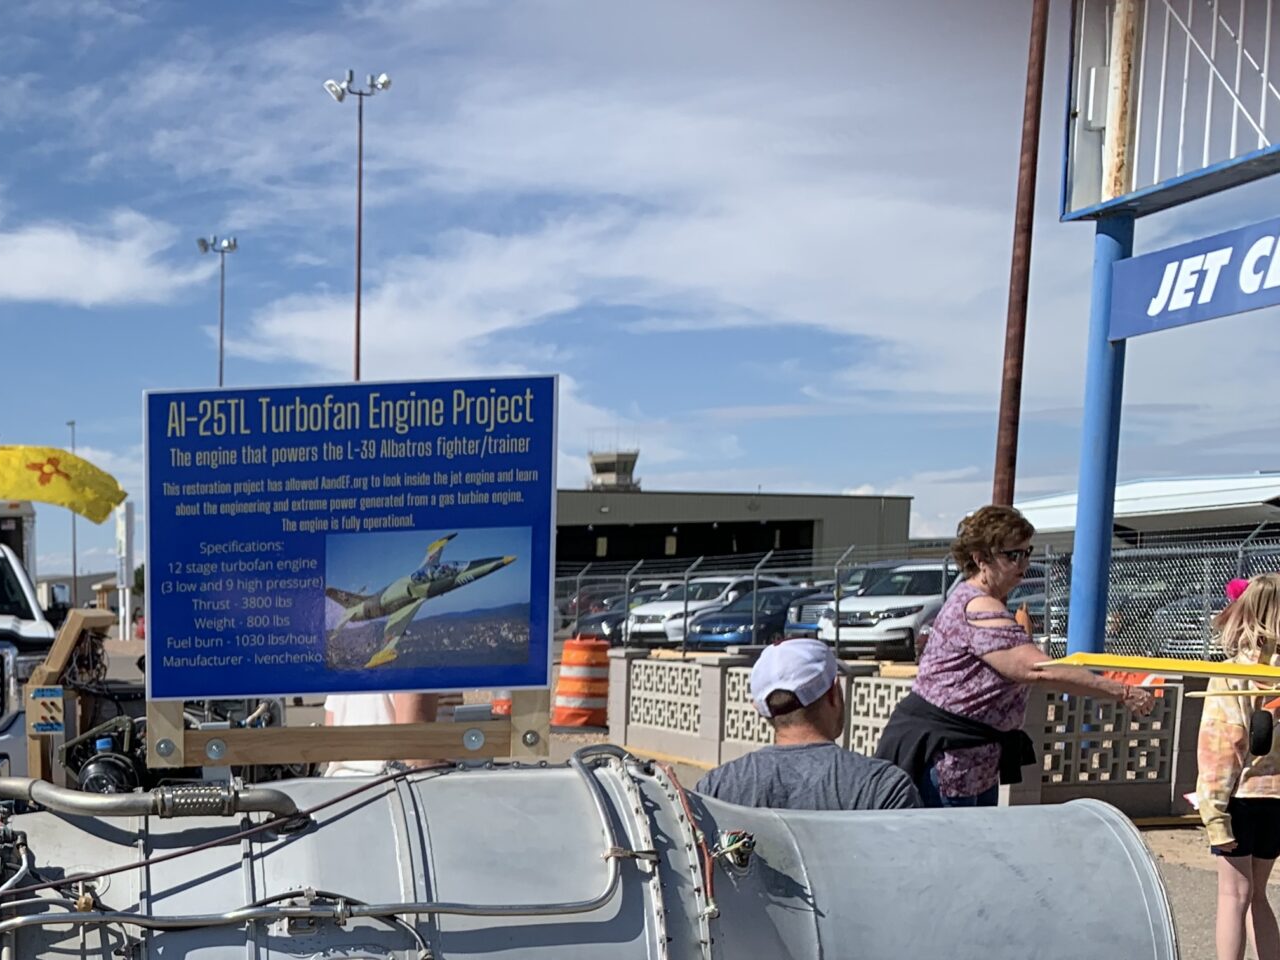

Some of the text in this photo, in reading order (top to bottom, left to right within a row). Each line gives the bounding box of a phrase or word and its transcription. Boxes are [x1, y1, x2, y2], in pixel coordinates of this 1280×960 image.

[1146, 246, 1233, 316] JET
[167, 387, 535, 438] AI-25TL Turbofan Engine Project
[170, 433, 531, 470] The engine that powers the L-39 Albatros fighter/trainer
[163, 468, 538, 496] This restoration project has allowed AandEF.org to look inside the jet engine and learn
[175, 489, 524, 516] about the engineering and extreme power generated from a gas turbine engine.
[282, 513, 415, 533] The engine is fully operational.
[199, 540, 284, 556] Specifications:
[168, 557, 317, 576] 12 stage turbofan engine
[161, 576, 324, 595] (3 low and 9 high pressure)
[192, 598, 230, 611] Thrust
[241, 597, 272, 609] 3800
[275, 596, 293, 608] lbs
[194, 617, 235, 632] Weight
[246, 616, 270, 628] 800
[273, 614, 290, 627] lbs
[167, 636, 191, 649] Fuel
[195, 635, 223, 648] burn
[235, 634, 264, 646] 1030
[268, 632, 317, 646] lbs/hour
[163, 654, 243, 667] Manufacturer
